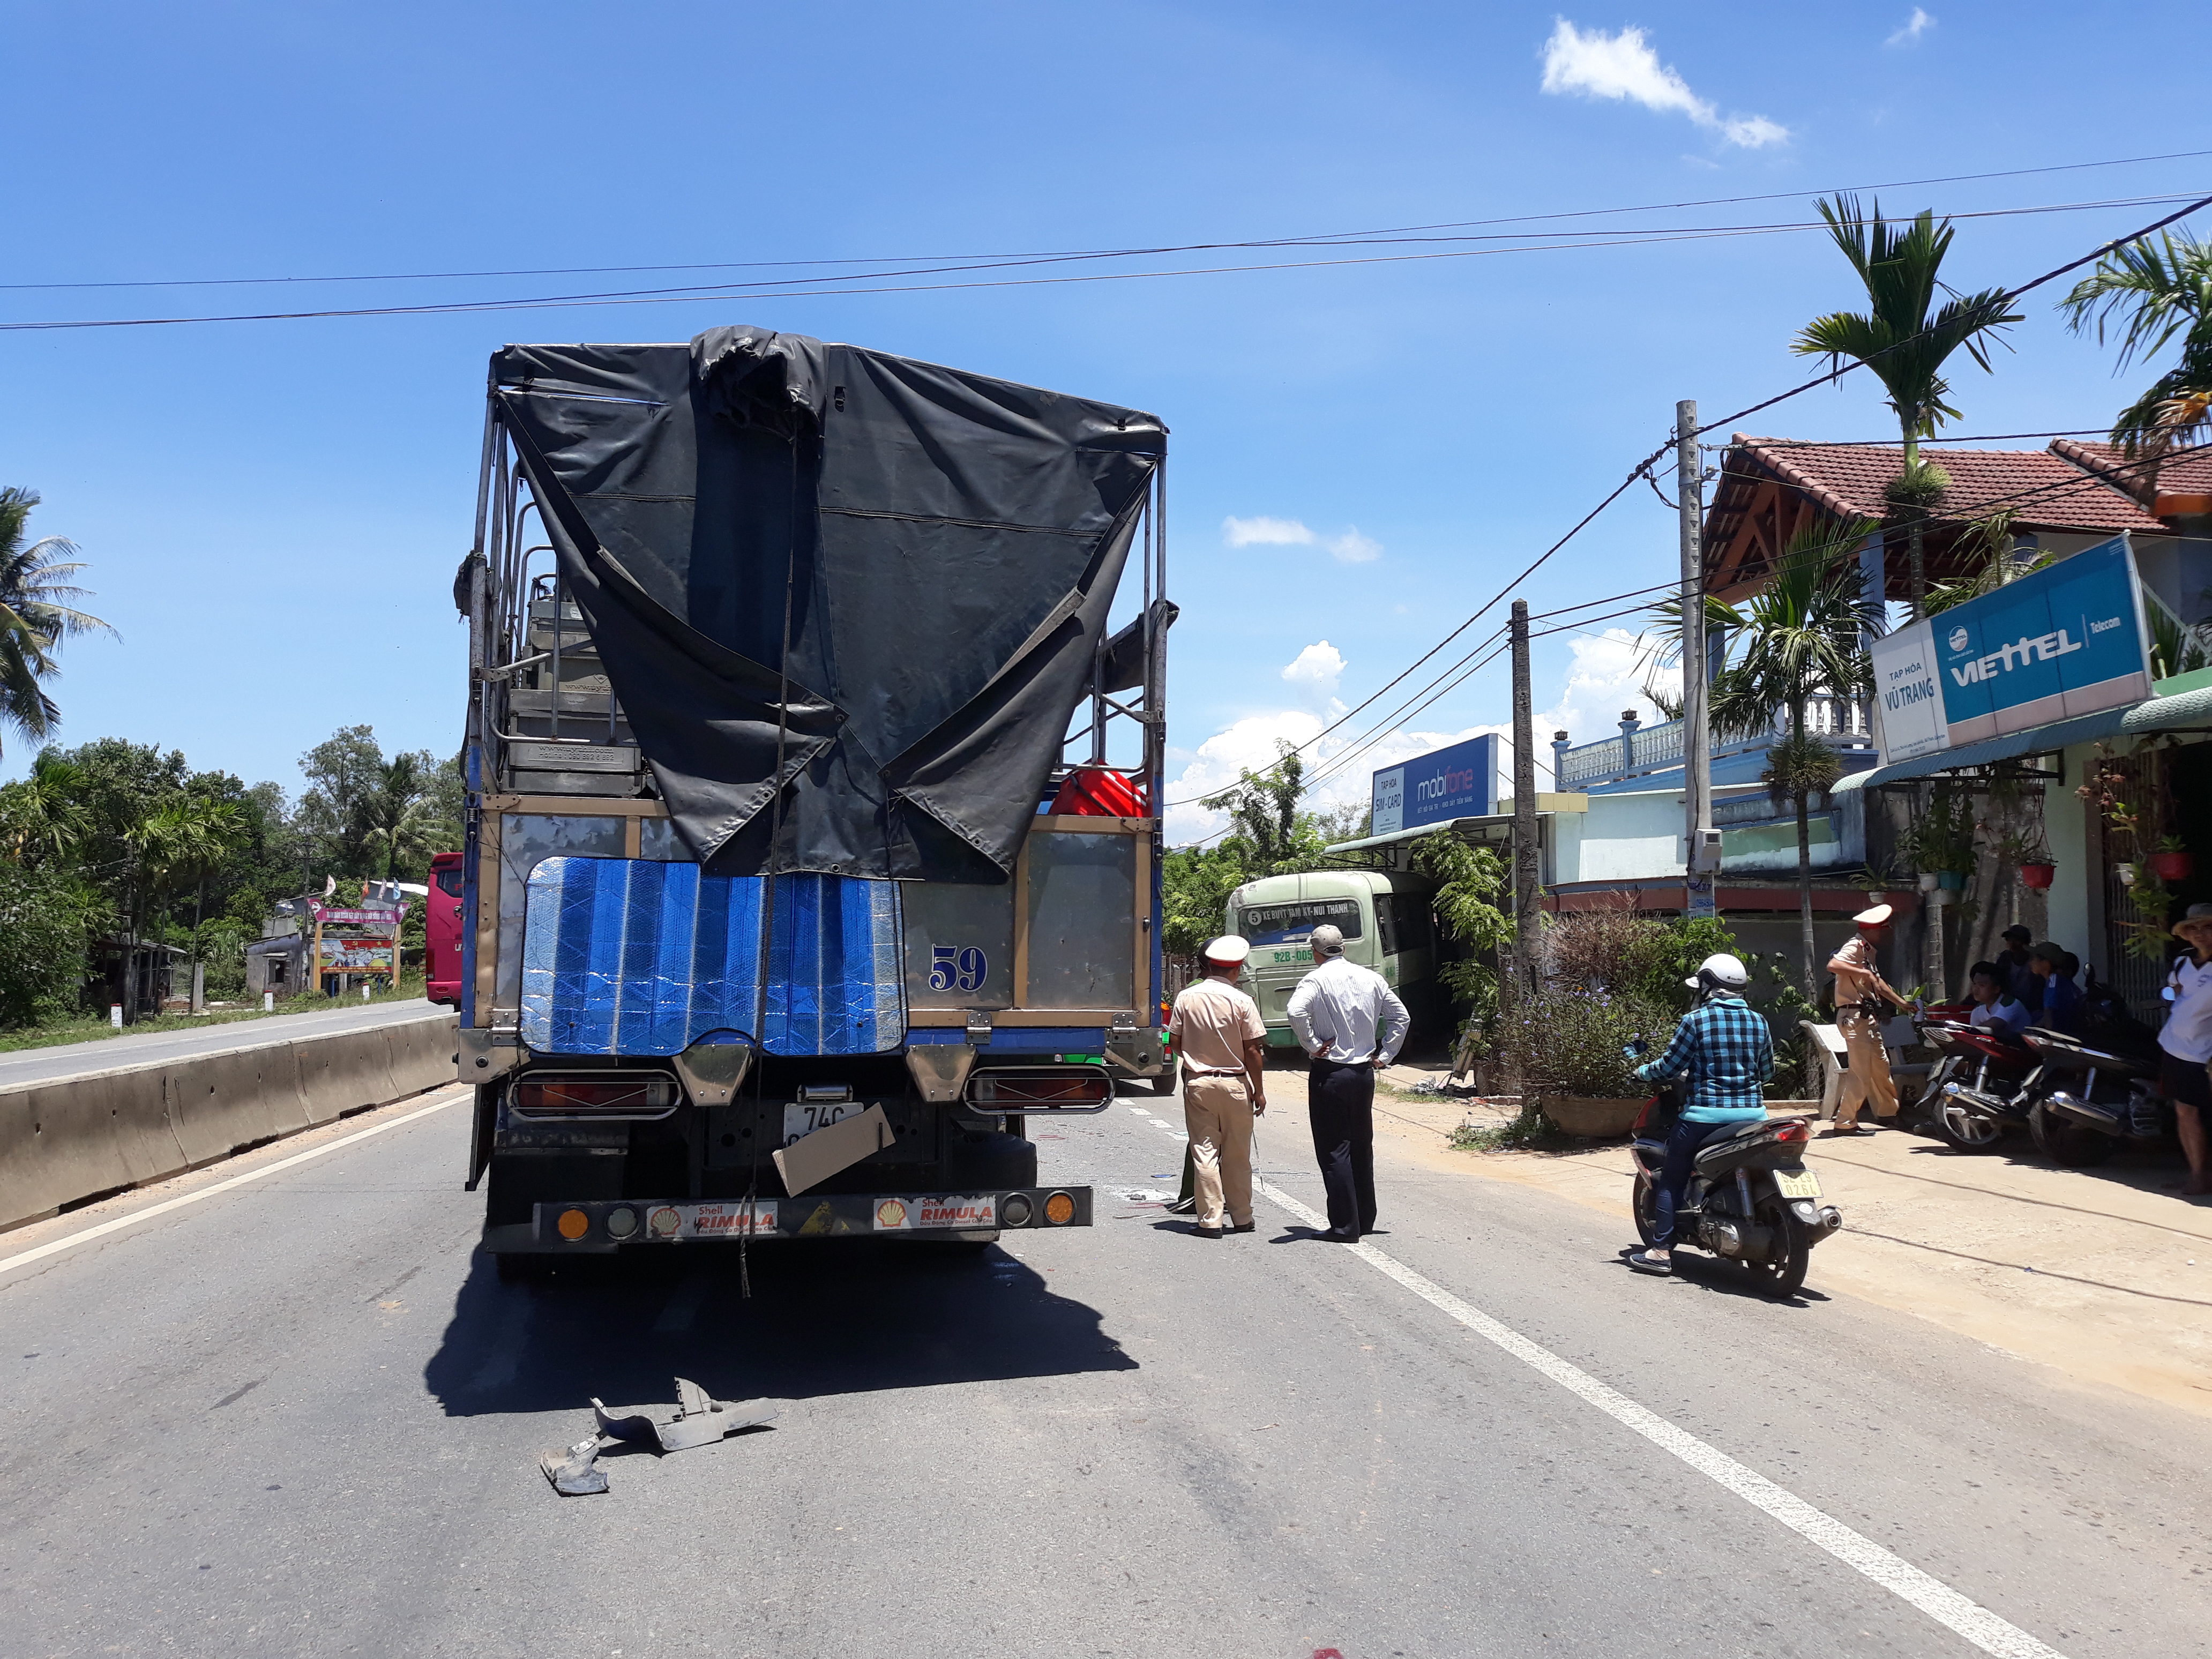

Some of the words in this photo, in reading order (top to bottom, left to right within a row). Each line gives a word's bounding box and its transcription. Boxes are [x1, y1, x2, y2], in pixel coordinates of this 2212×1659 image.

[2090, 617, 2120, 634] Telecom
[1950, 629, 2082, 687] VIETTEL
[1889, 669, 1903, 682] TẠP
[1905, 662, 1923, 676] HÓA
[1885, 686, 1900, 712] VŨ
[1899, 677, 1934, 707] TRANG
[1417, 765, 1473, 802] mobifone
[1387, 793, 1402, 809] CARD
[1251, 913, 1257, 923] 5
[1262, 910, 1271, 921] XE
[1274, 950, 1314, 962] 92B-005
[929, 944, 988, 992] 59
[804, 1107, 845, 1131] 74C
[699, 1205, 723, 1215] Shell
[920, 1206, 993, 1221] RIMULA
[698, 1214, 774, 1228] RIMUA
